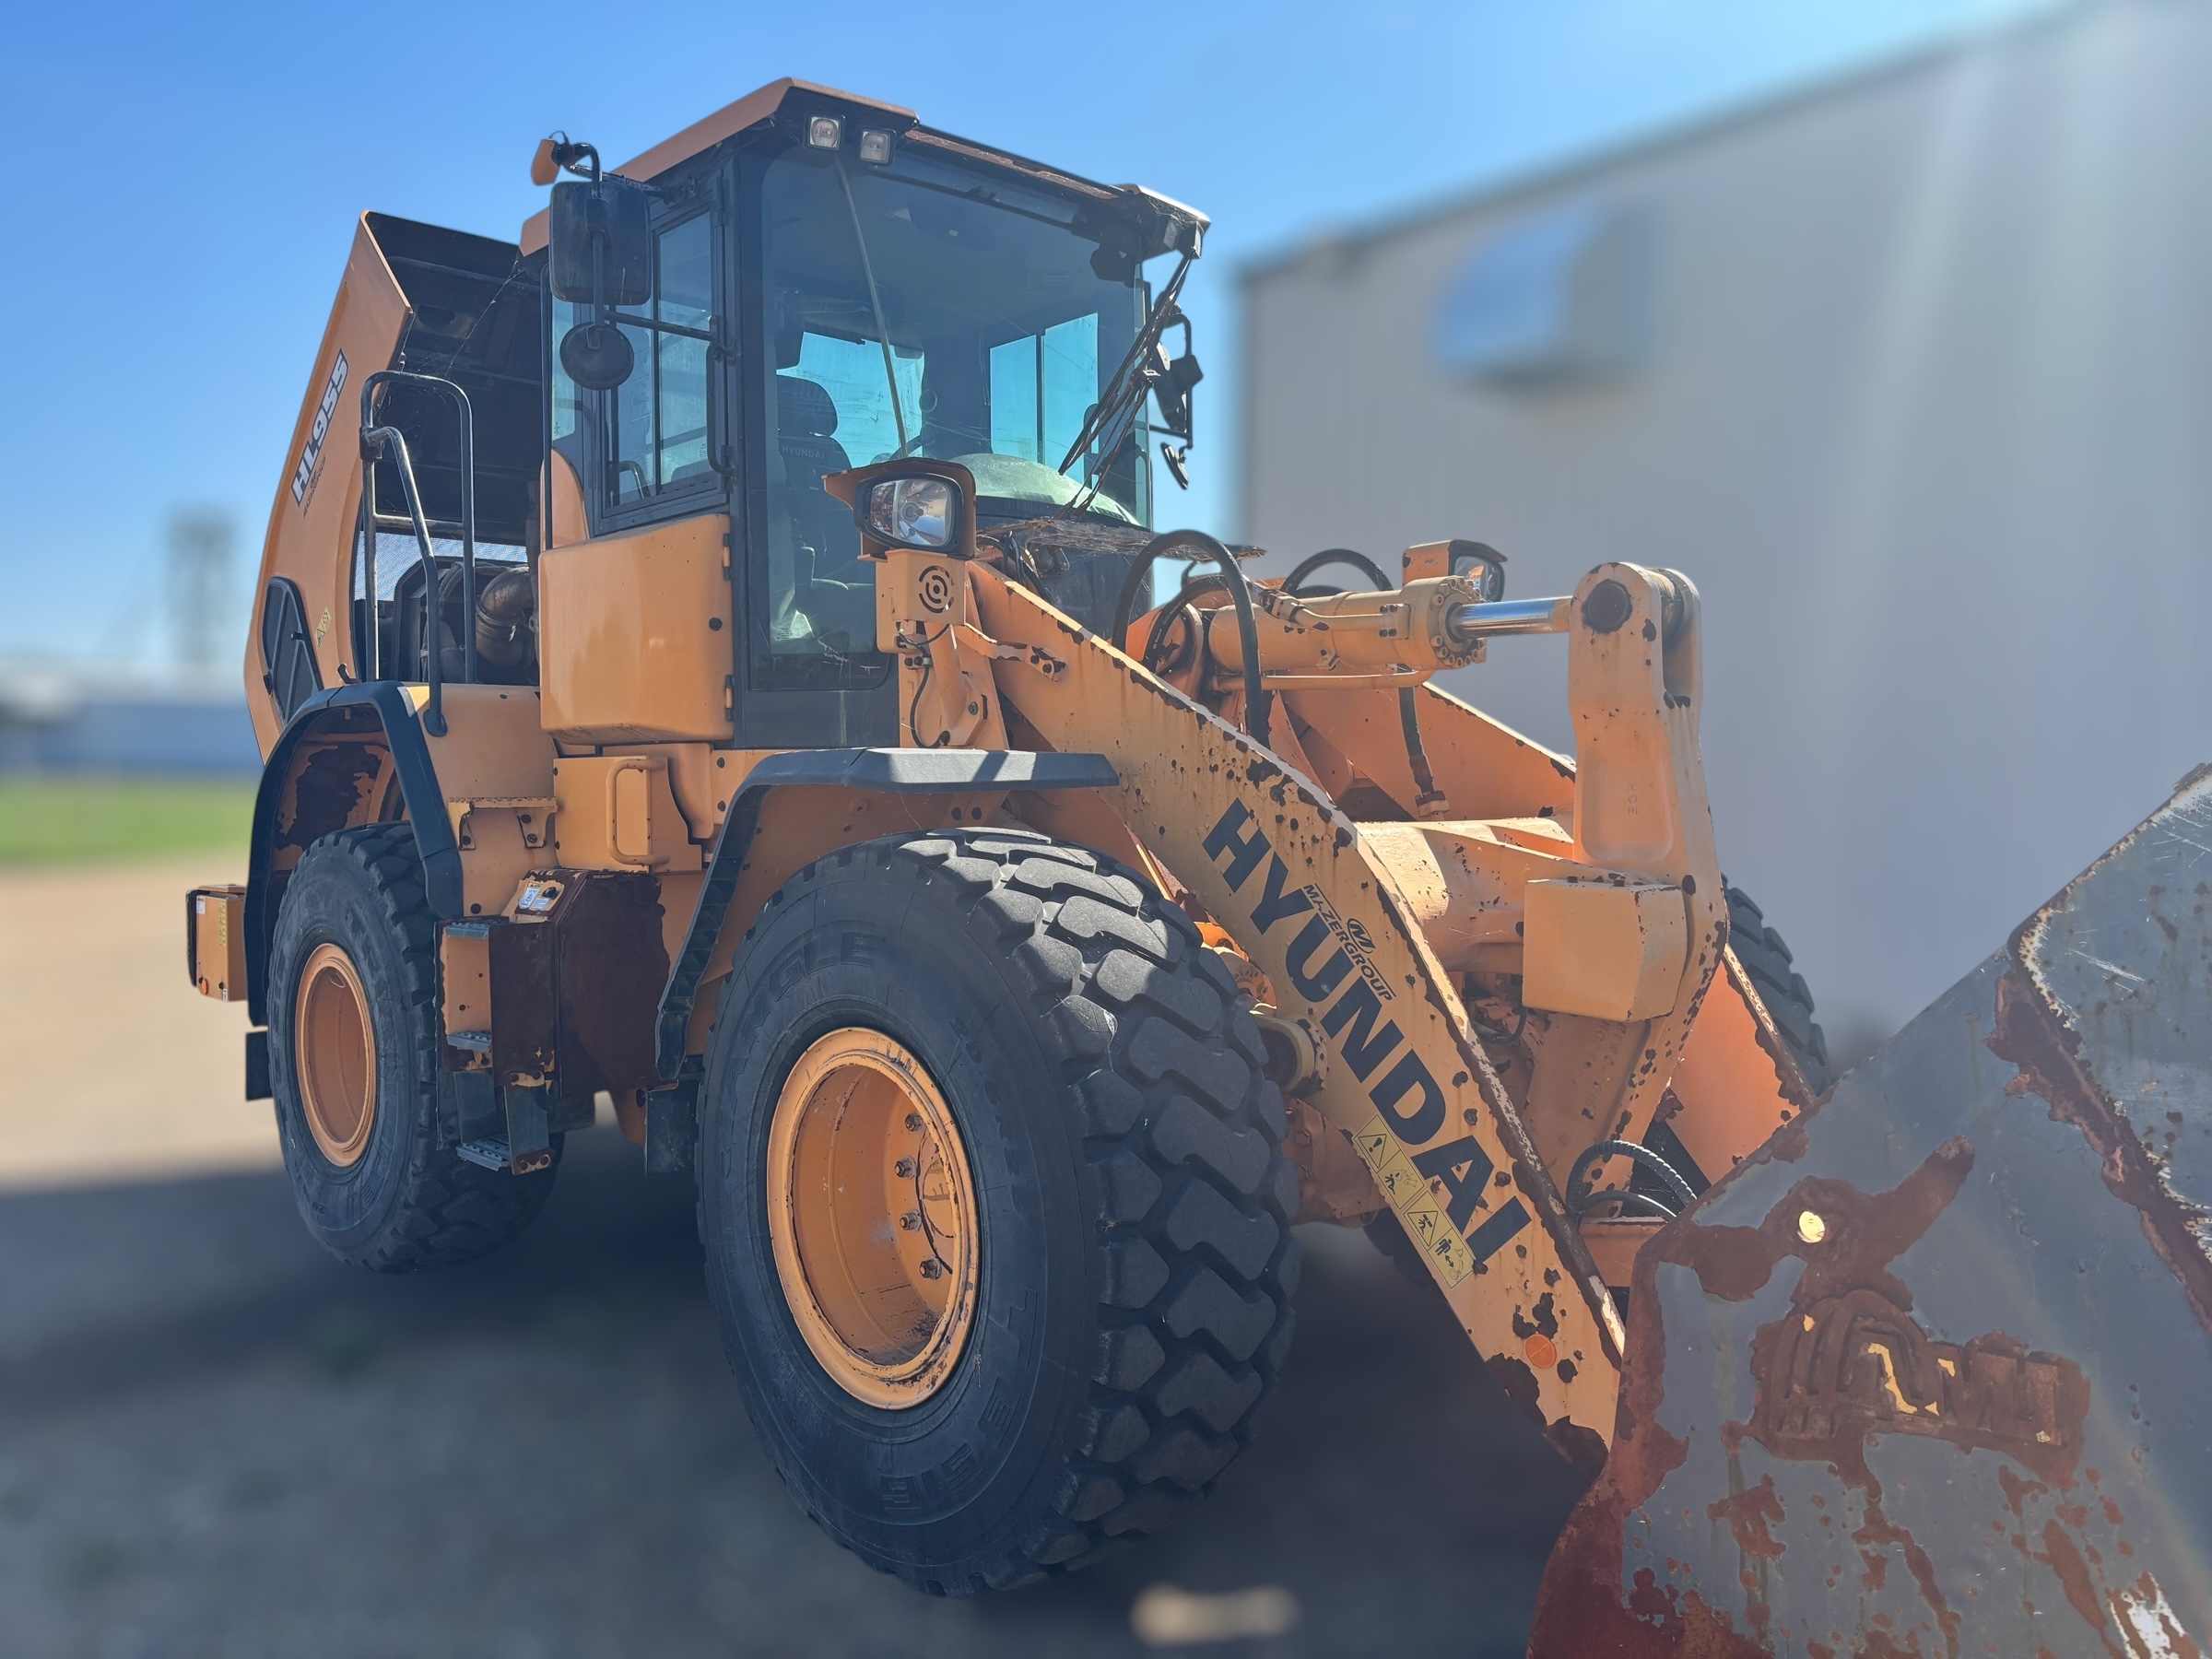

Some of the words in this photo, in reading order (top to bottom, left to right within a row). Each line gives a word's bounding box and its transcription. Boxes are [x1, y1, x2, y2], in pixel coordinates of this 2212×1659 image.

[290, 348, 348, 507] HL955
[782, 445, 825, 460] HYUNDAI
[1303, 884, 1393, 1002] MAZERGROUP
[1202, 797, 1531, 1263] HYUNDAI
